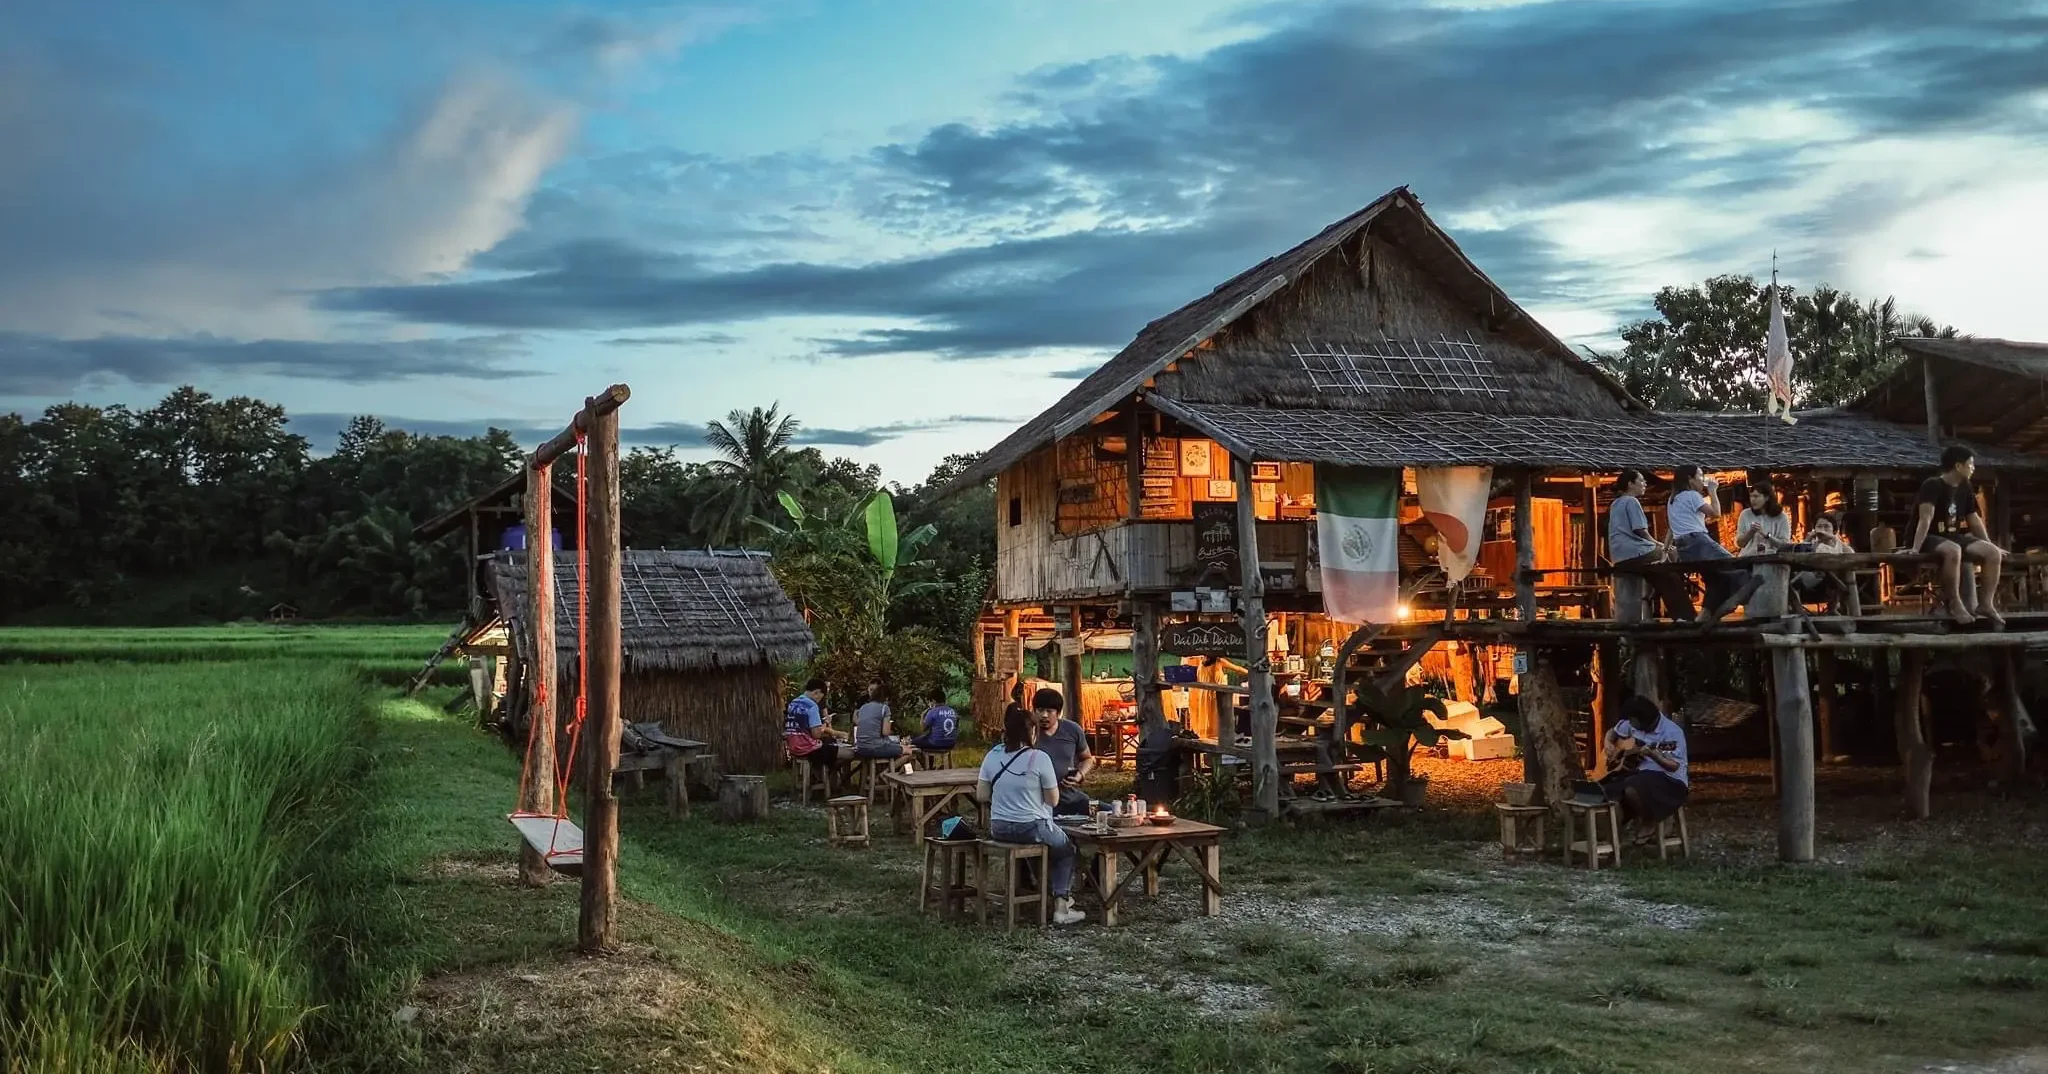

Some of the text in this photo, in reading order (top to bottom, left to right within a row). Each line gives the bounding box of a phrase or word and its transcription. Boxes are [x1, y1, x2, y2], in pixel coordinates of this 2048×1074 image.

[1173, 633, 1191, 646] Dai
[1212, 632, 1229, 646] Dai
[943, 718, 954, 736] 9
